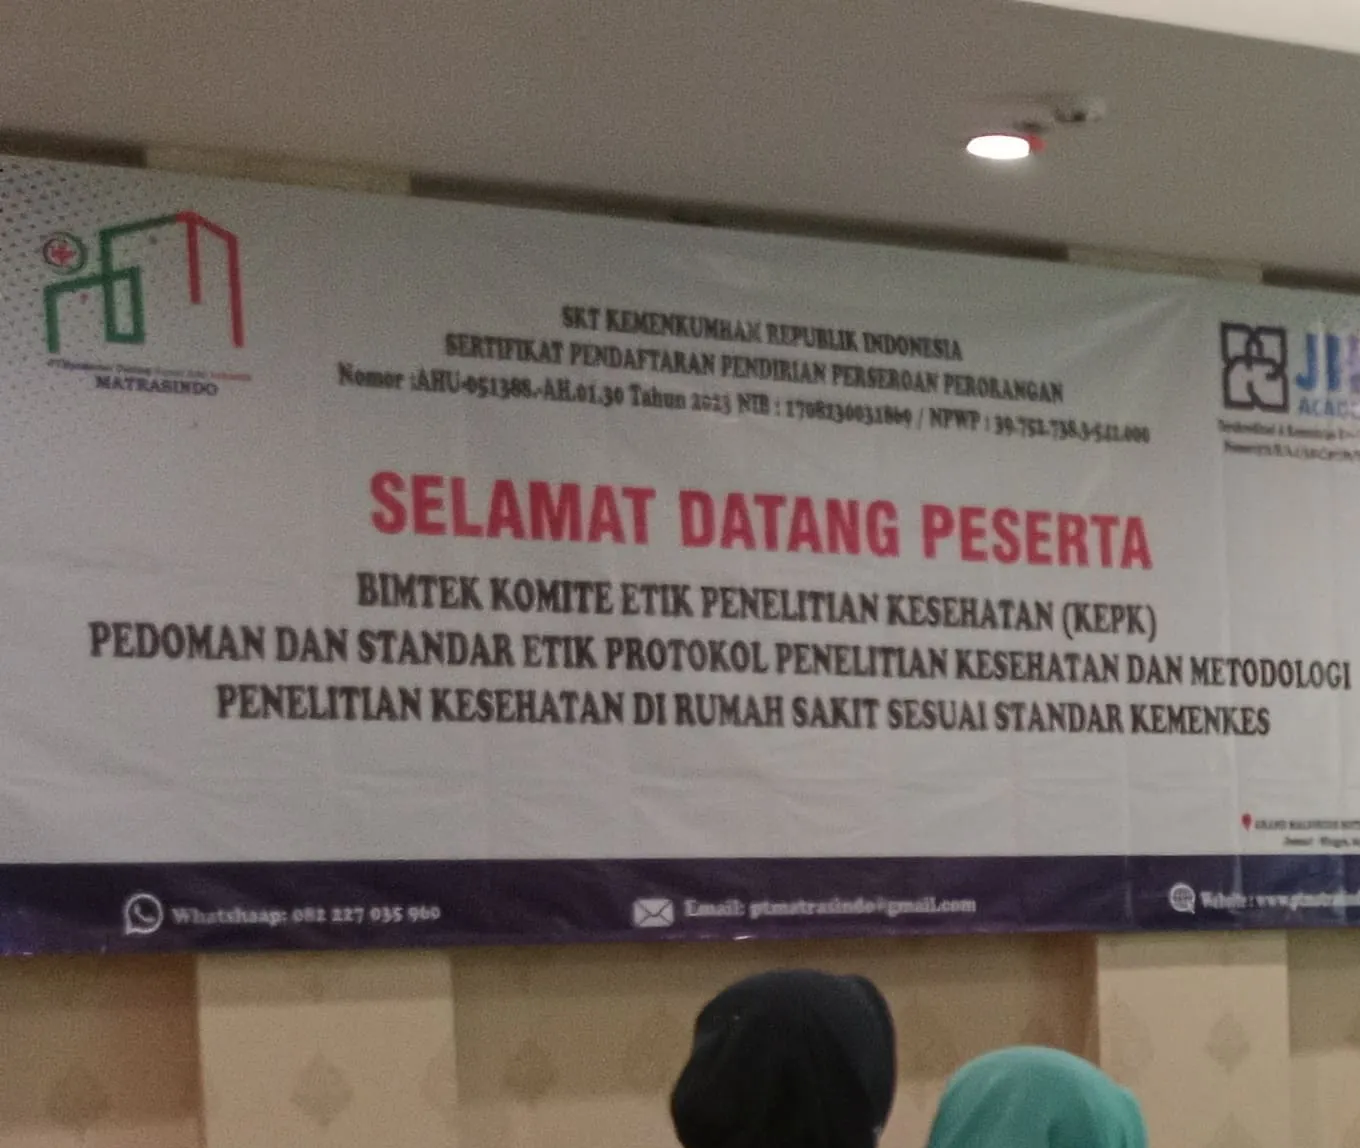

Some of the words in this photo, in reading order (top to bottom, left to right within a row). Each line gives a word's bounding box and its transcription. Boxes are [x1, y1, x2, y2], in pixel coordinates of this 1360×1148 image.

[561, 305, 600, 331] SKT
[766, 322, 858, 352] REPUBLIK
[862, 332, 963, 361] INDONESIA
[338, 361, 404, 389] Nomor
[629, 383, 686, 410] Tahun
[737, 392, 770, 416] NIB
[929, 407, 981, 431] NPWP
[445, 333, 563, 365] SERTIFIKAT
[569, 343, 715, 376] PENDAFTARAN
[721, 354, 826, 385] PENDIRIAN
[831, 363, 938, 394] PERSEROAN
[943, 373, 1064, 404] PERORANGAN
[370, 470, 656, 545] SELAMAT
[679, 489, 900, 557] DATANG
[921, 503, 1153, 569] PESERTA
[356, 571, 484, 610] BIMTEK
[490, 577, 615, 615] KOMITE
[621, 582, 694, 618] ETIK
[701, 585, 879, 624] PENELITIAN
[887, 594, 1054, 632] KESEHATAN
[1063, 600, 1157, 642] (KEPK)
[88, 620, 266, 661] PEDOMAN
[275, 625, 348, 663] DAN
[357, 629, 516, 667] STANDAR
[523, 635, 597, 669] ETIK
[605, 635, 768, 674] PROTOKOL
[775, 640, 949, 679] PENELITIAN
[955, 647, 1119, 684] KESEHATAN
[1127, 653, 1183, 686] DAN
[1190, 655, 1352, 690] METODOLOGI
[216, 683, 422, 722] PENELITIAN
[430, 687, 624, 725] KESEHATAN
[633, 692, 667, 726] DI
[674, 692, 785, 728] RUMAH
[792, 696, 880, 730] SAKIT
[888, 697, 988, 732] SESUAI
[994, 701, 1124, 734] STANDAR
[1131, 703, 1271, 736] KEMENKES
[293, 908, 325, 924] 082
[331, 908, 364, 924] 227
[370, 906, 402, 924] 035
[408, 905, 441, 923] 960
[684, 898, 745, 918] Email:
